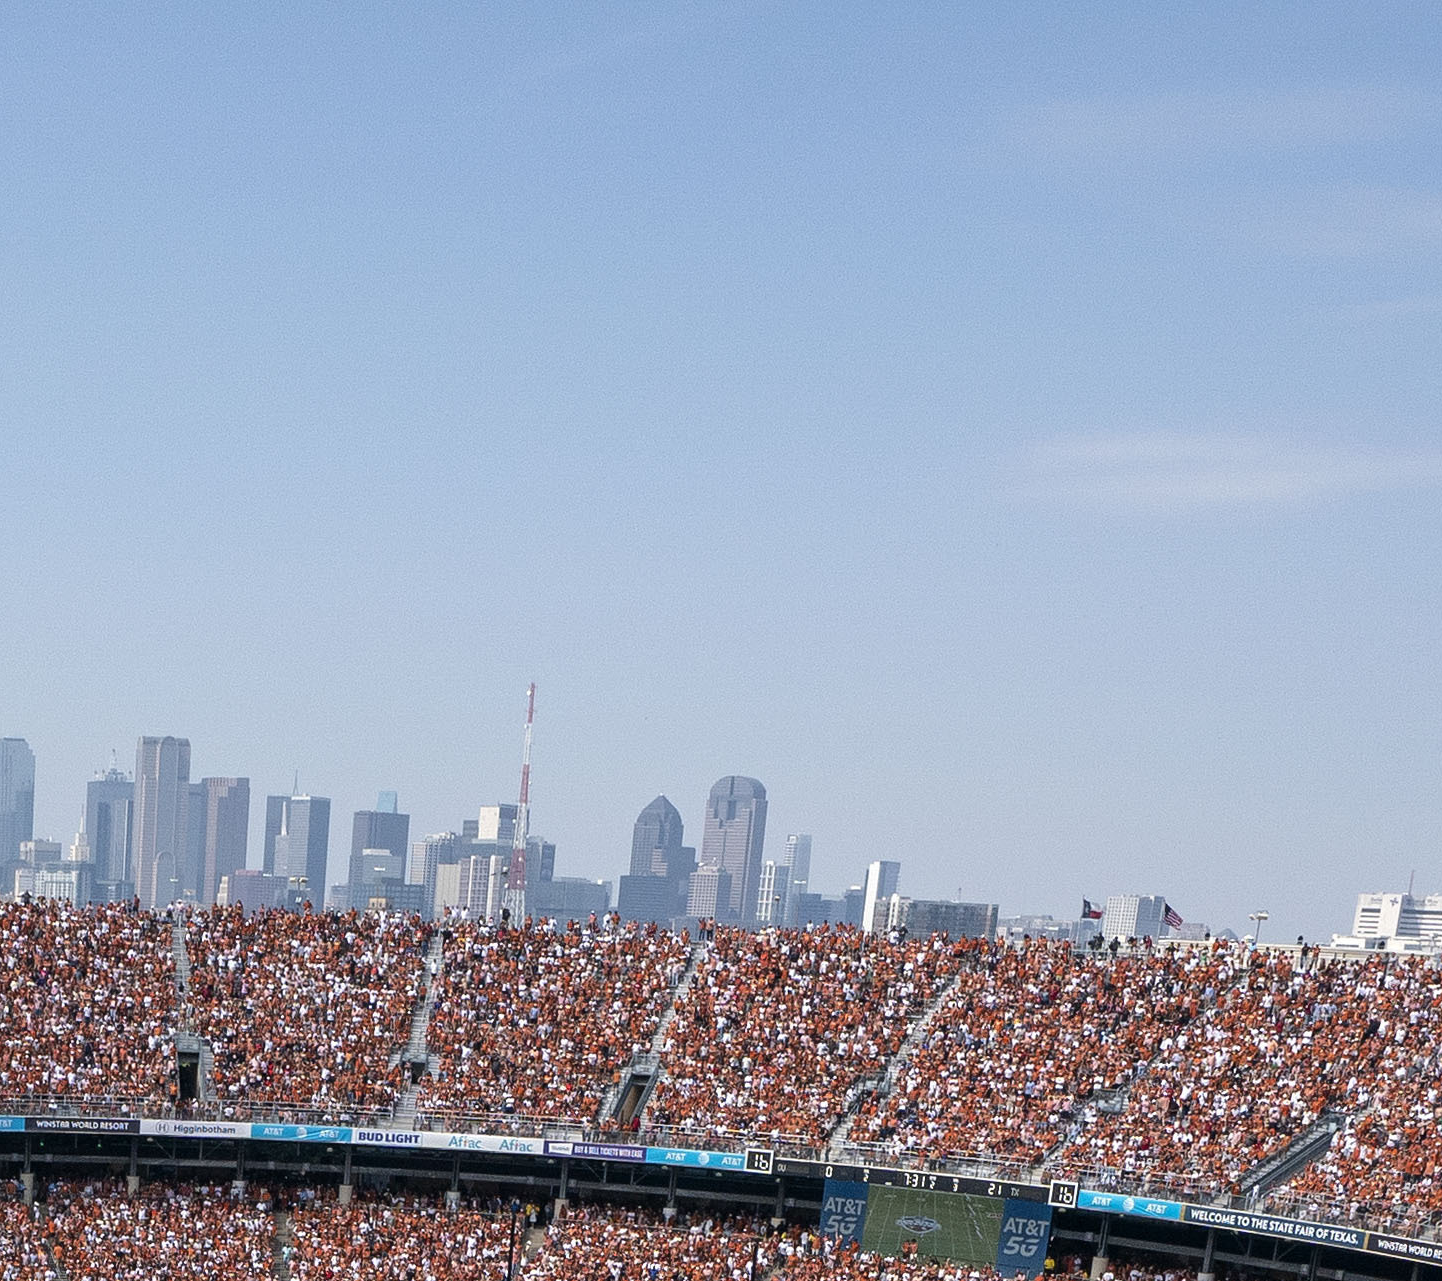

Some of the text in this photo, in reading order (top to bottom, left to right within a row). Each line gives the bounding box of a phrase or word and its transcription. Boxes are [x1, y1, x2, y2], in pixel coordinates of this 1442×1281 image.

[71, 1120, 99, 1130] WORLD
[100, 1121, 129, 1131] RESORT
[174, 1125, 236, 1135] Higginbotham
[263, 1127, 284, 1136] AT&T
[358, 1132, 420, 1144] BUD LIGHT
[665, 1152, 743, 1166] AT&T AT&T
[825, 1166, 833, 1177] 0
[904, 1173, 925, 1187] 7:31
[988, 1183, 1002, 1195] 21
[824, 1197, 866, 1216] AT&T
[1091, 1196, 1166, 1215] AT&T AT&T
[824, 1216, 855, 1235] 5G
[1003, 1218, 1049, 1237] AT&T
[1190, 1208, 1358, 1245] WELCOME TO THE STATE FAIR OF TEXAS.
[1004, 1237, 1040, 1257] 5G
[1408, 1245, 1433, 1259] WORLD
